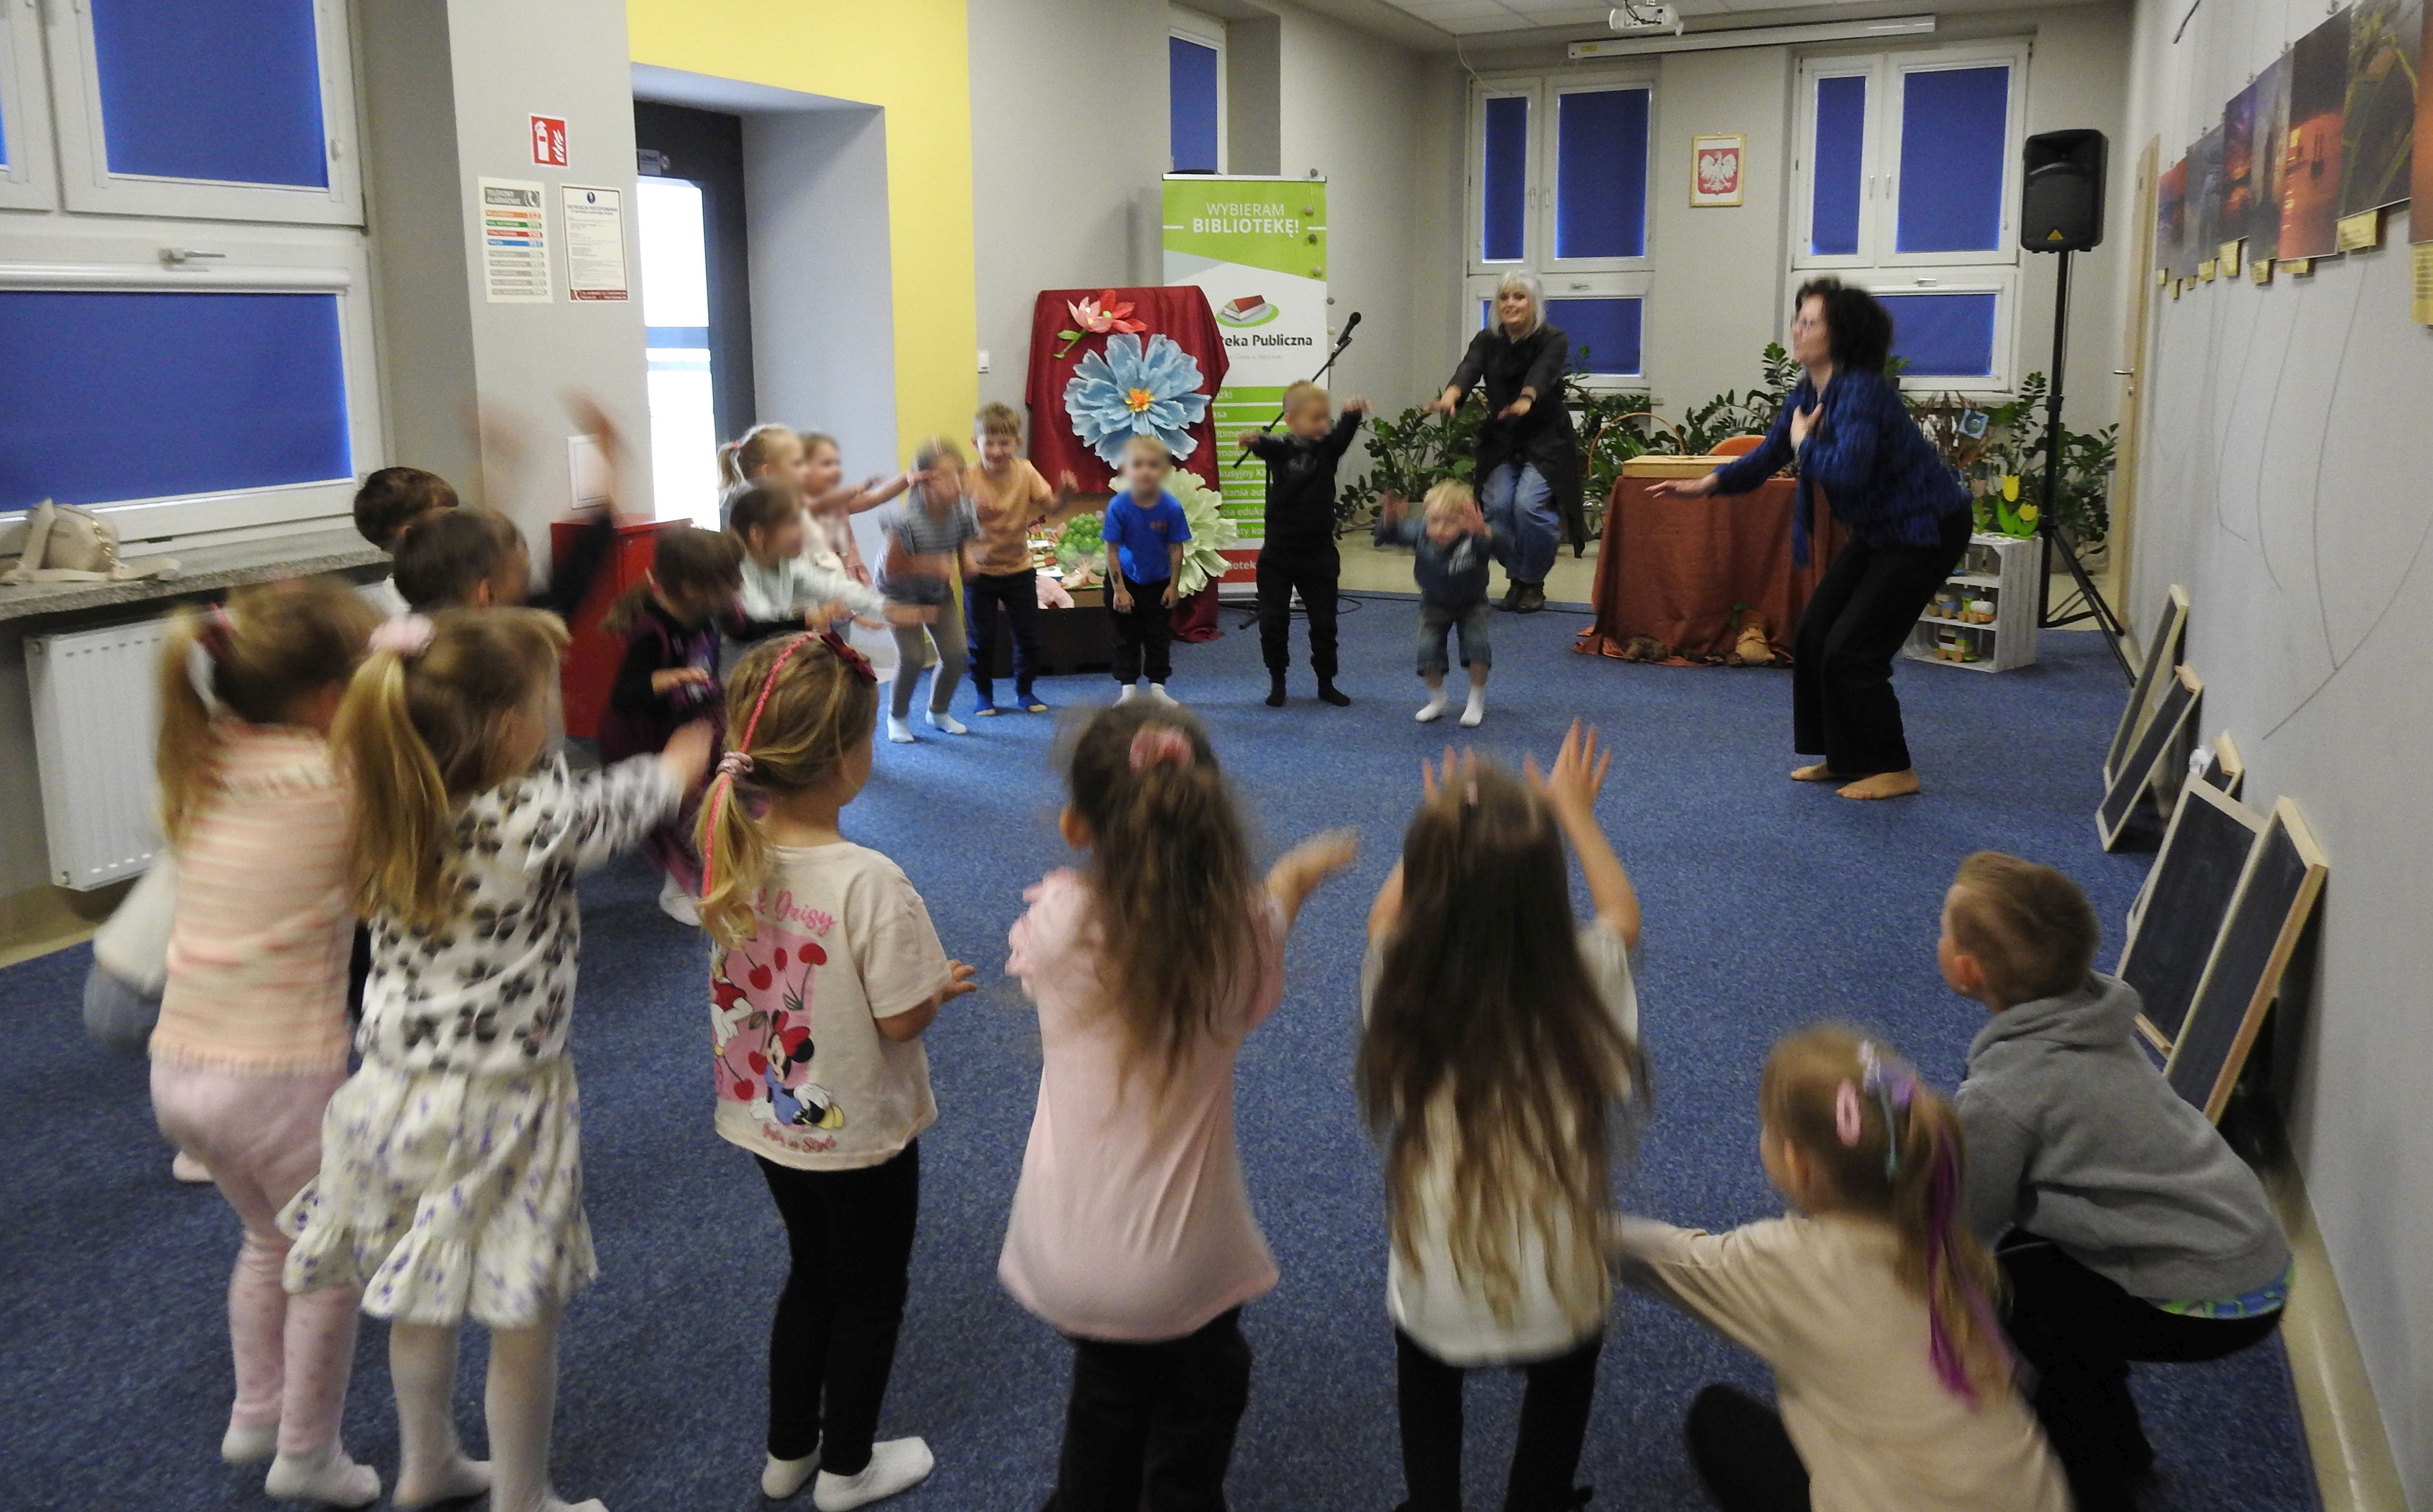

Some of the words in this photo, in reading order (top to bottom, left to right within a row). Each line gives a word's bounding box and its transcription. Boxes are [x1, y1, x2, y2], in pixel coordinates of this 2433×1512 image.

[1206, 203, 1285, 216] WYBIERAM
[1193, 218, 1299, 238] BIBLIOTEKĘ!
[1223, 334, 1248, 346] eka
[1252, 334, 1313, 346] Publiczna
[1237, 507, 1266, 516] eduka
[774, 890, 835, 937] Daisy
